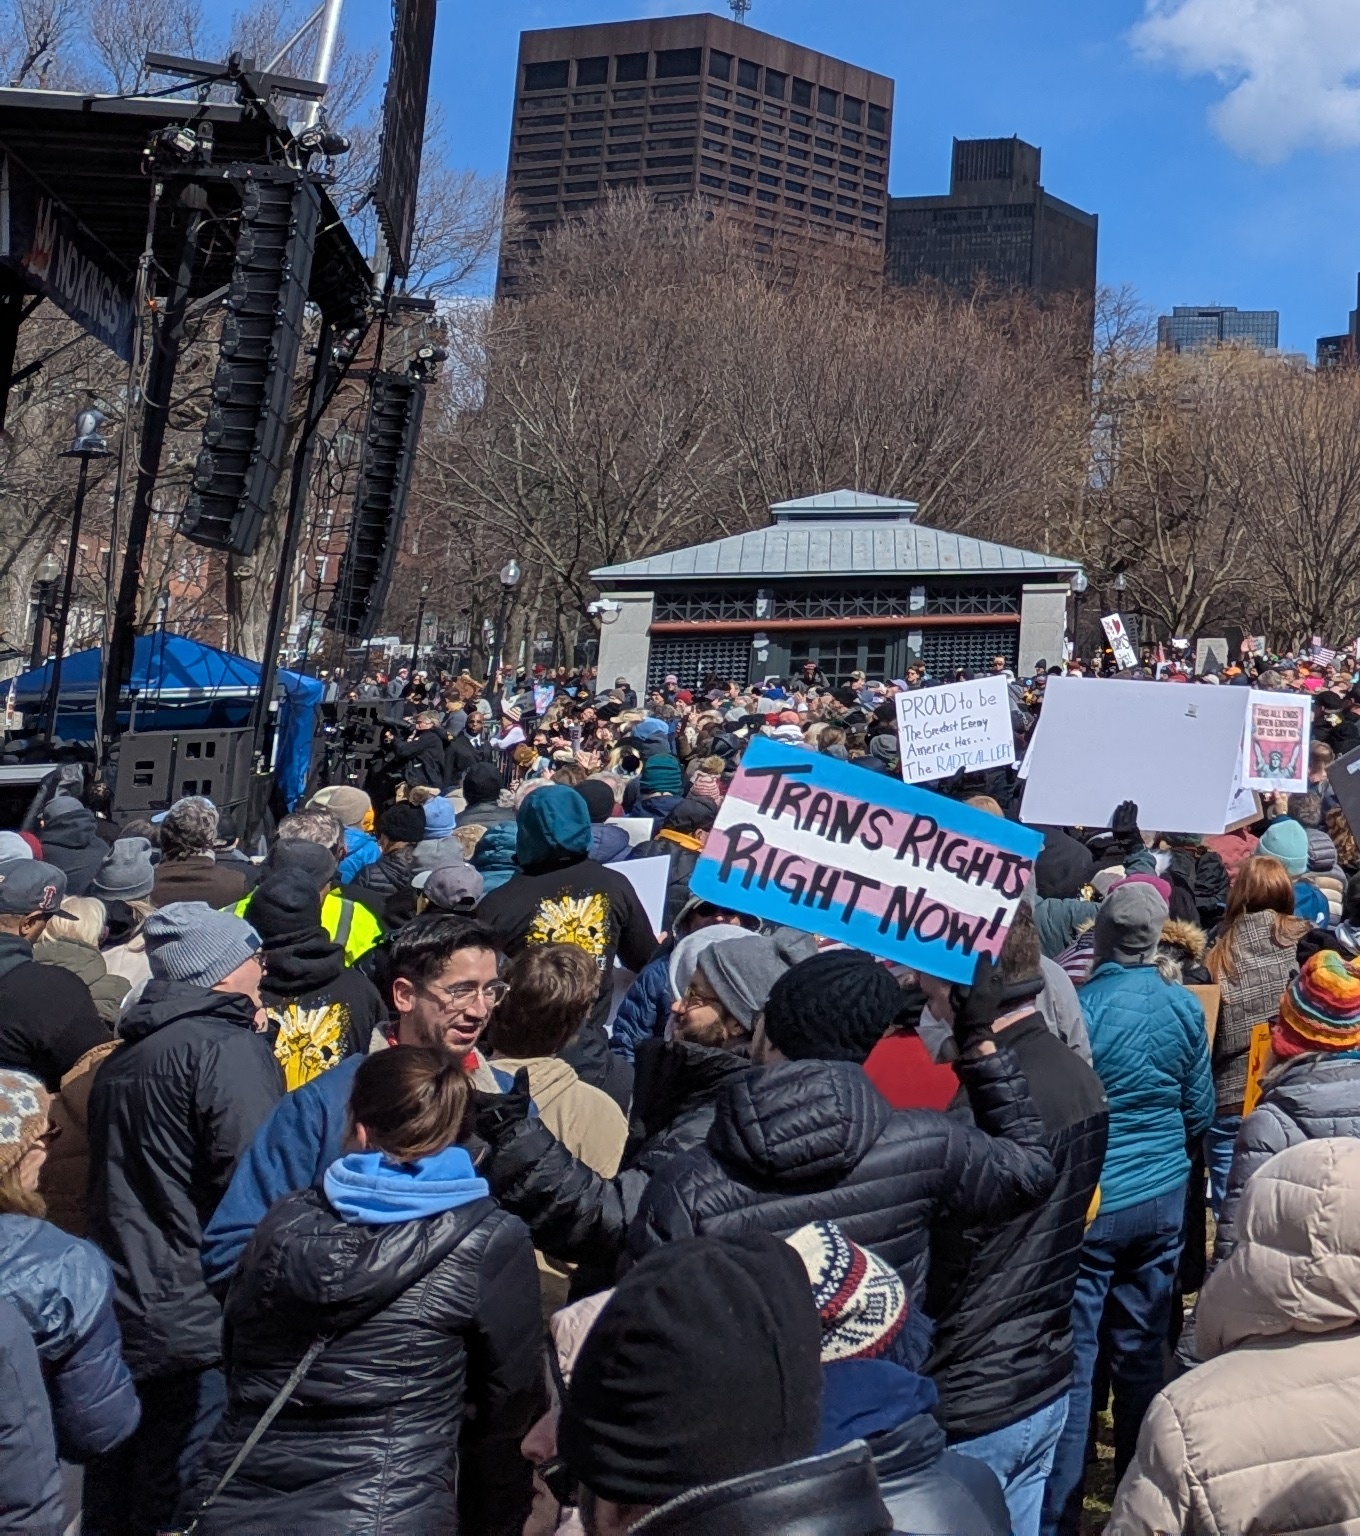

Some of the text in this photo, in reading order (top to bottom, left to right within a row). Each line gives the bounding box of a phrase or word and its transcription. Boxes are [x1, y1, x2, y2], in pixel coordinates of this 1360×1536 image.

[73, 255, 122, 335] KINGS
[901, 688, 997, 722] PROUD to be
[1257, 707, 1298, 719] THIS ALL ENDS
[923, 721, 959, 739] Greatest
[1256, 717, 1298, 728] WHEN ENOUGH
[1257, 727, 1297, 738] OF US SAY NO
[906, 742, 951, 760] America
[904, 761, 932, 780] The
[936, 749, 989, 773] RADICAL
[744, 764, 1035, 901] TRANS RIGHTS
[718, 822, 1008, 957] RIGHT NOW!
